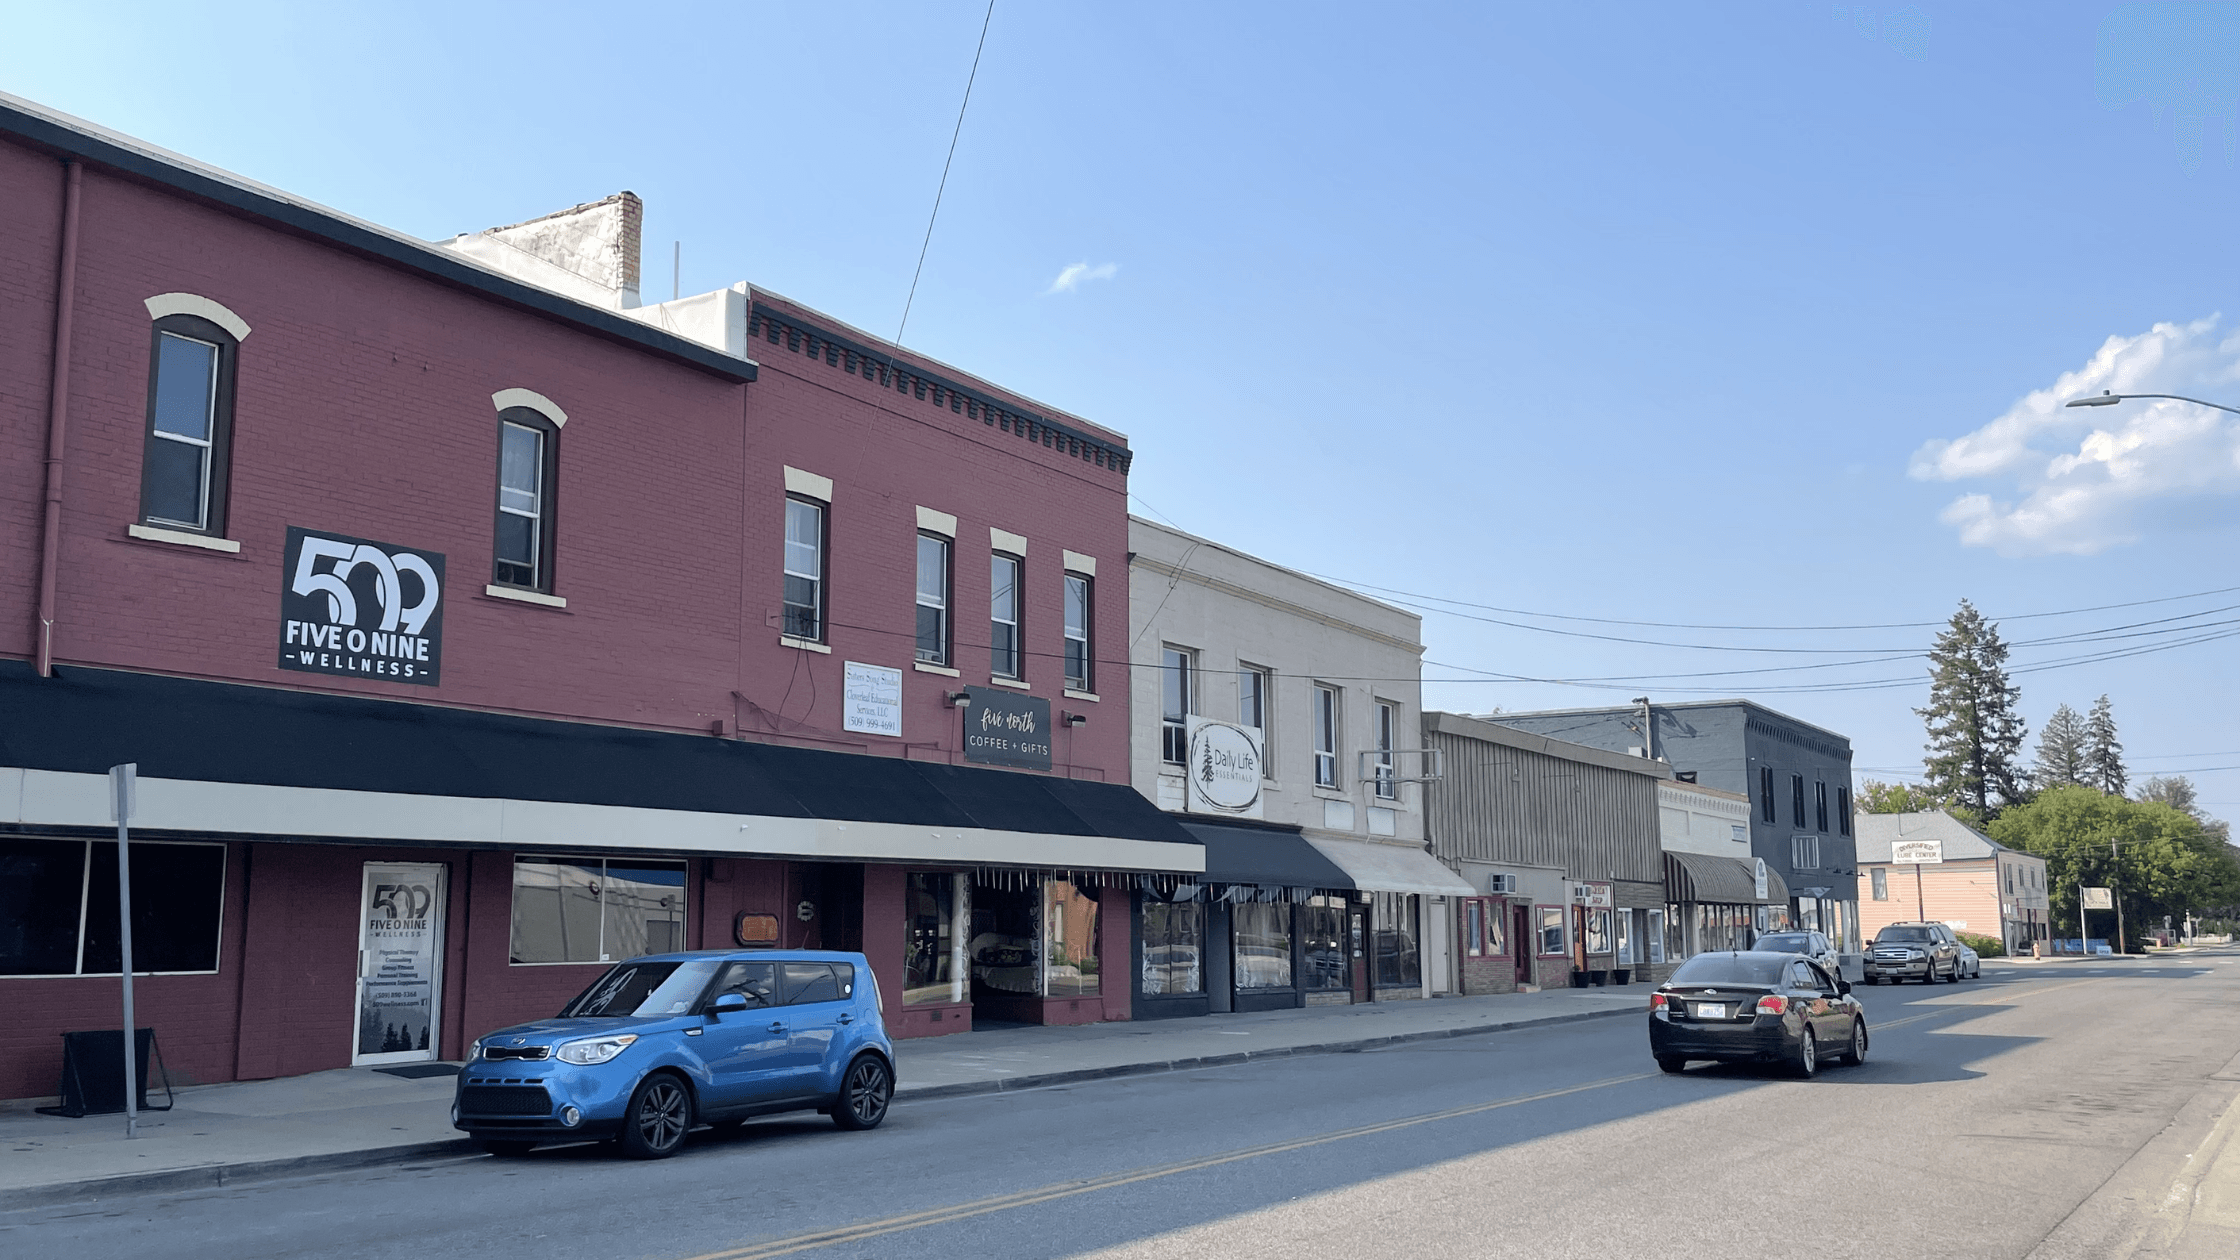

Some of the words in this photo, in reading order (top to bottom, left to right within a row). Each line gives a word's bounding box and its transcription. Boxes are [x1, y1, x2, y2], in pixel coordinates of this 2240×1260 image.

[291, 535, 440, 636] 509
[286, 619, 343, 651] FIVE
[346, 628, 367, 653] O
[371, 631, 430, 662] NINE
[299, 650, 414, 678] WELLNESS
[877, 706, 889, 718] LLC
[981, 707, 1004, 732] five
[1006, 711, 1036, 734] north
[969, 735, 1008, 750] COFFEE
[1021, 742, 1048, 756] GIFTS
[1214, 749, 1237, 772] Daily
[1237, 752, 1254, 771] Life
[1215, 769, 1253, 783] ESSENTIALS
[372, 884, 431, 919] 509
[370, 919, 392, 930] FIVE
[393, 919, 402, 930] O
[403, 919, 427, 930] NINE
